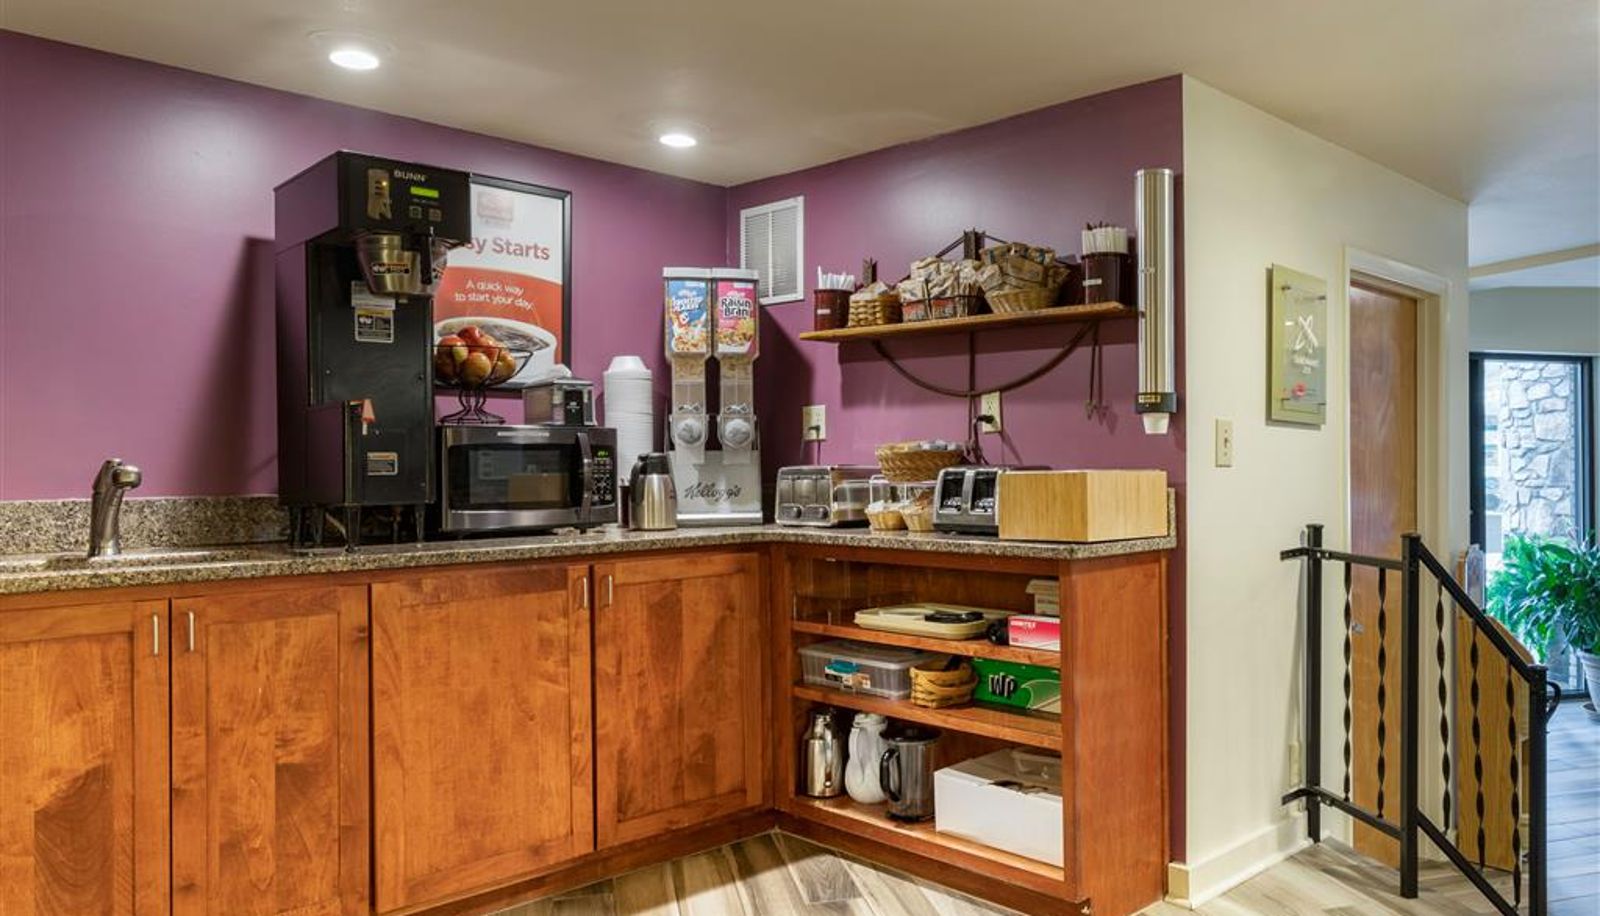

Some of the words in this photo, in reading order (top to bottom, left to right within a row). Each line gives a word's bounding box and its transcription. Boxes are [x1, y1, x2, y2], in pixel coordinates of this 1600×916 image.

[393, 169, 427, 182] BUNN
[492, 237, 550, 260] Starts
[466, 280, 475, 289] A
[477, 280, 502, 293] quick
[504, 284, 525, 297] way
[455, 292, 466, 301] to
[468, 292, 490, 302] start
[491, 295, 514, 307] your
[721, 297, 751, 308] Raisin
[724, 306, 749, 317] Bran
